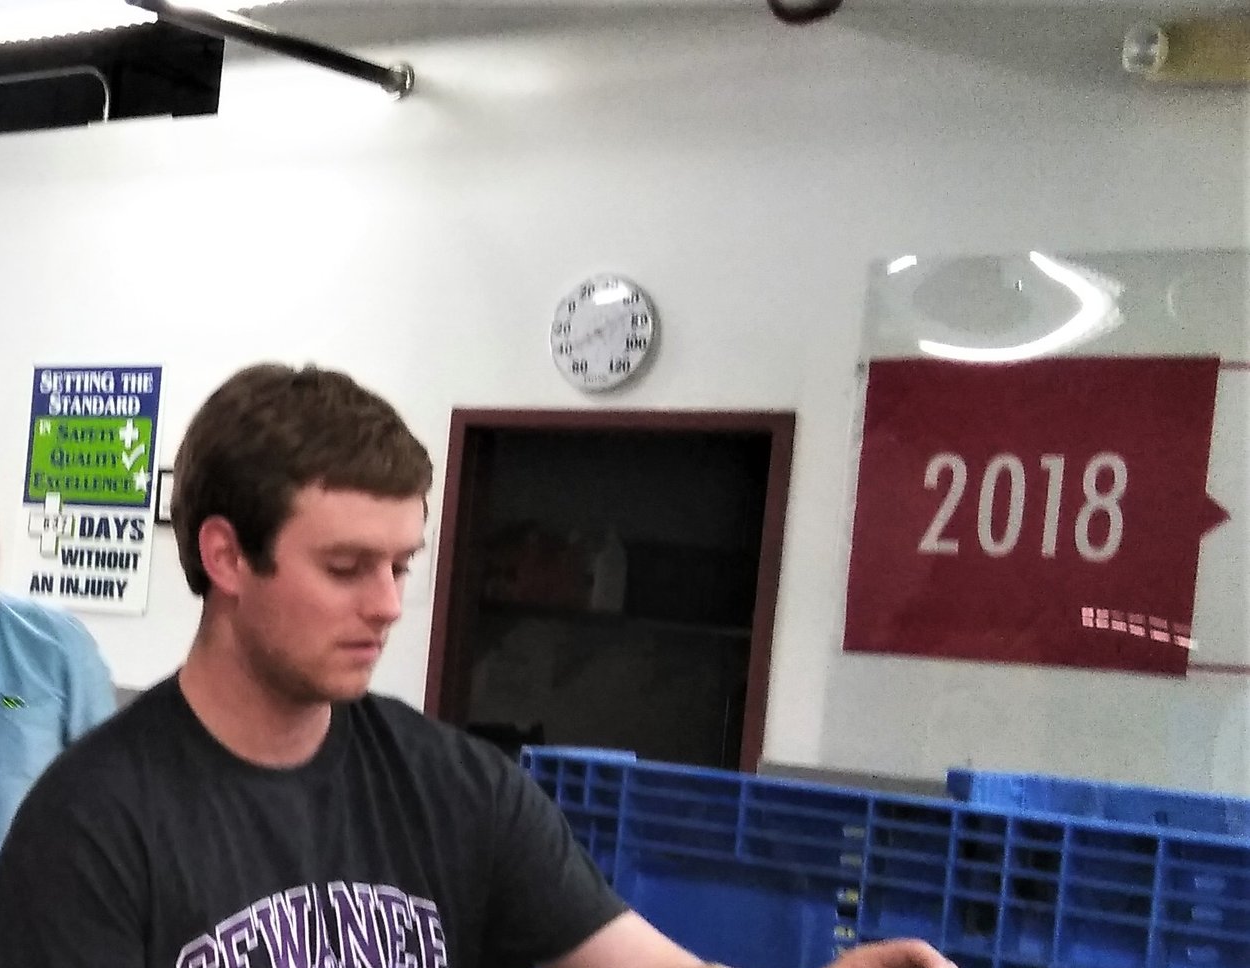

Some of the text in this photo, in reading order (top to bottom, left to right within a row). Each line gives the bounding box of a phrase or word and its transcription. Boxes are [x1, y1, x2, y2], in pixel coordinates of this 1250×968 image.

[39, 369, 154, 394] SETTING THE
[48, 393, 142, 417] STANDARD
[50, 448, 119, 470] QUALITY
[917, 451, 1129, 563] 2018
[78, 515, 145, 541] DAYS
[61, 545, 142, 571] WITHOUT
[29, 571, 128, 600] AN INJURY
